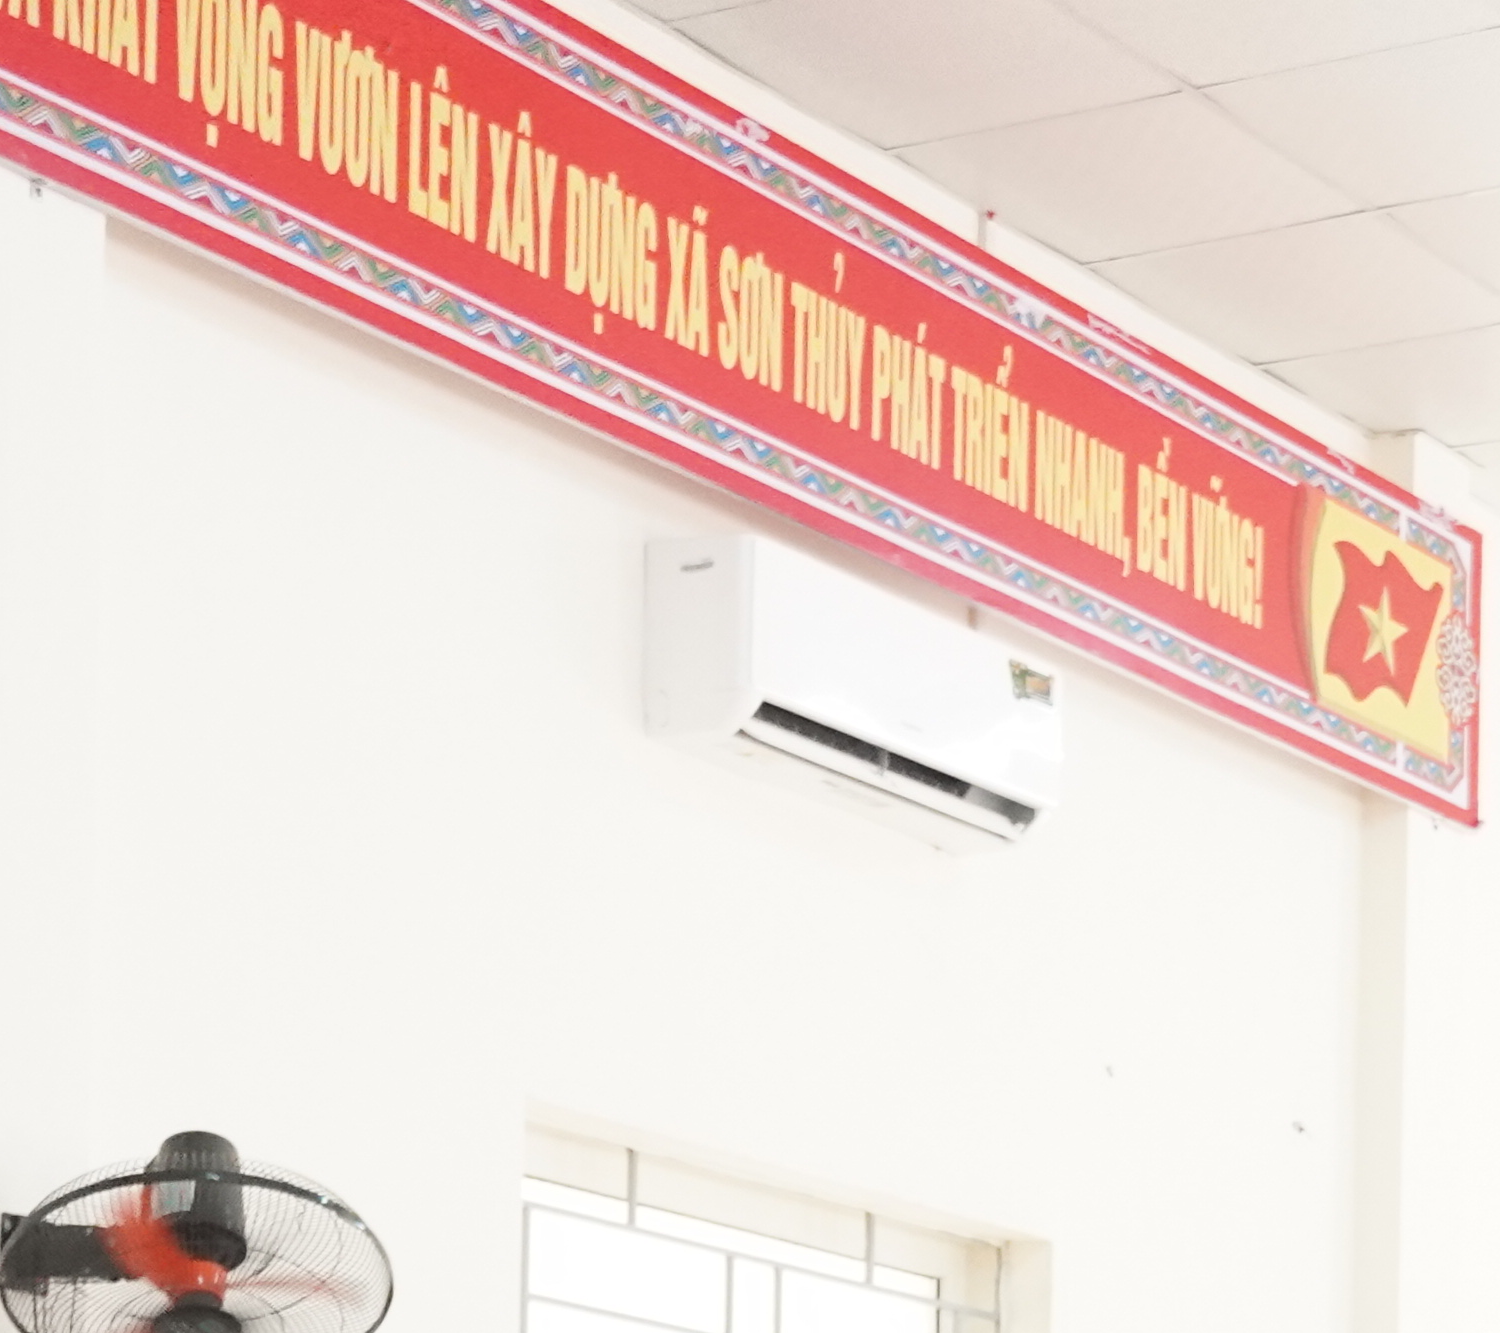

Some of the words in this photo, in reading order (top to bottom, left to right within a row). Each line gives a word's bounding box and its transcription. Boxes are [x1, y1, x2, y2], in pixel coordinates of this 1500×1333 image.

[176, 0, 284, 148] VỌNG
[295, 20, 399, 204] VƯƠN
[408, 65, 479, 243] LÊN
[486, 111, 558, 280] XÂY
[564, 164, 659, 334] DỰNG
[665, 204, 710, 358] XÃ
[717, 244, 784, 393] SƠN
[790, 251, 866, 431] THỦY
[871, 322, 946, 471] PHÁT
[950, 344, 1030, 513] TRIỂN
[1034, 409, 1131, 578] NHANH,
[1136, 436, 1188, 592] BỀN
[1191, 475, 1264, 629] VỮNG!
